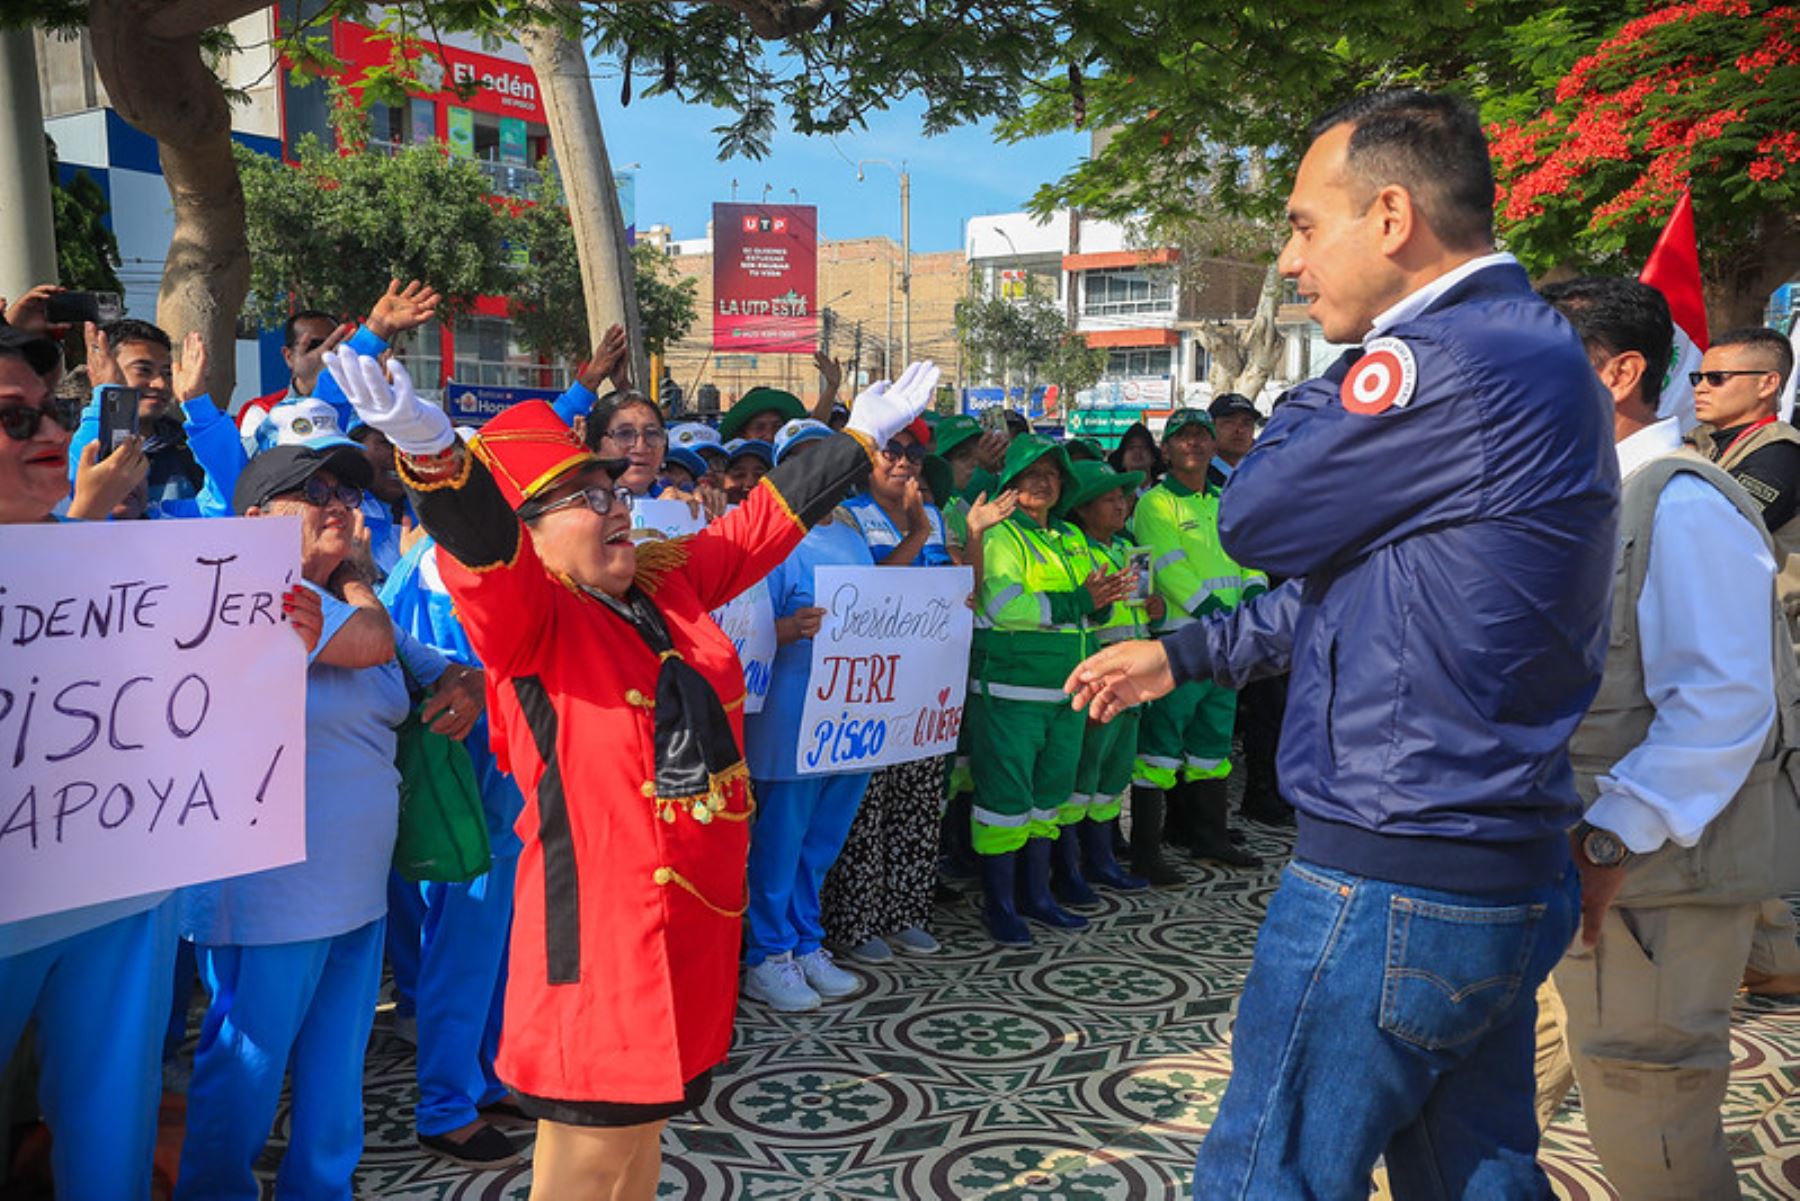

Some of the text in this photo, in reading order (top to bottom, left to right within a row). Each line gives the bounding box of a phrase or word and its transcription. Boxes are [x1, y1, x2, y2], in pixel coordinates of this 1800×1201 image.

[453, 62, 535, 99] El edén
[745, 218, 785, 231] UTP
[719, 299, 738, 315] LA
[742, 301, 769, 315] UTP
[831, 582, 952, 643] Presidente
[816, 653, 901, 704] JERI
[0, 769, 219, 849] APOYA
